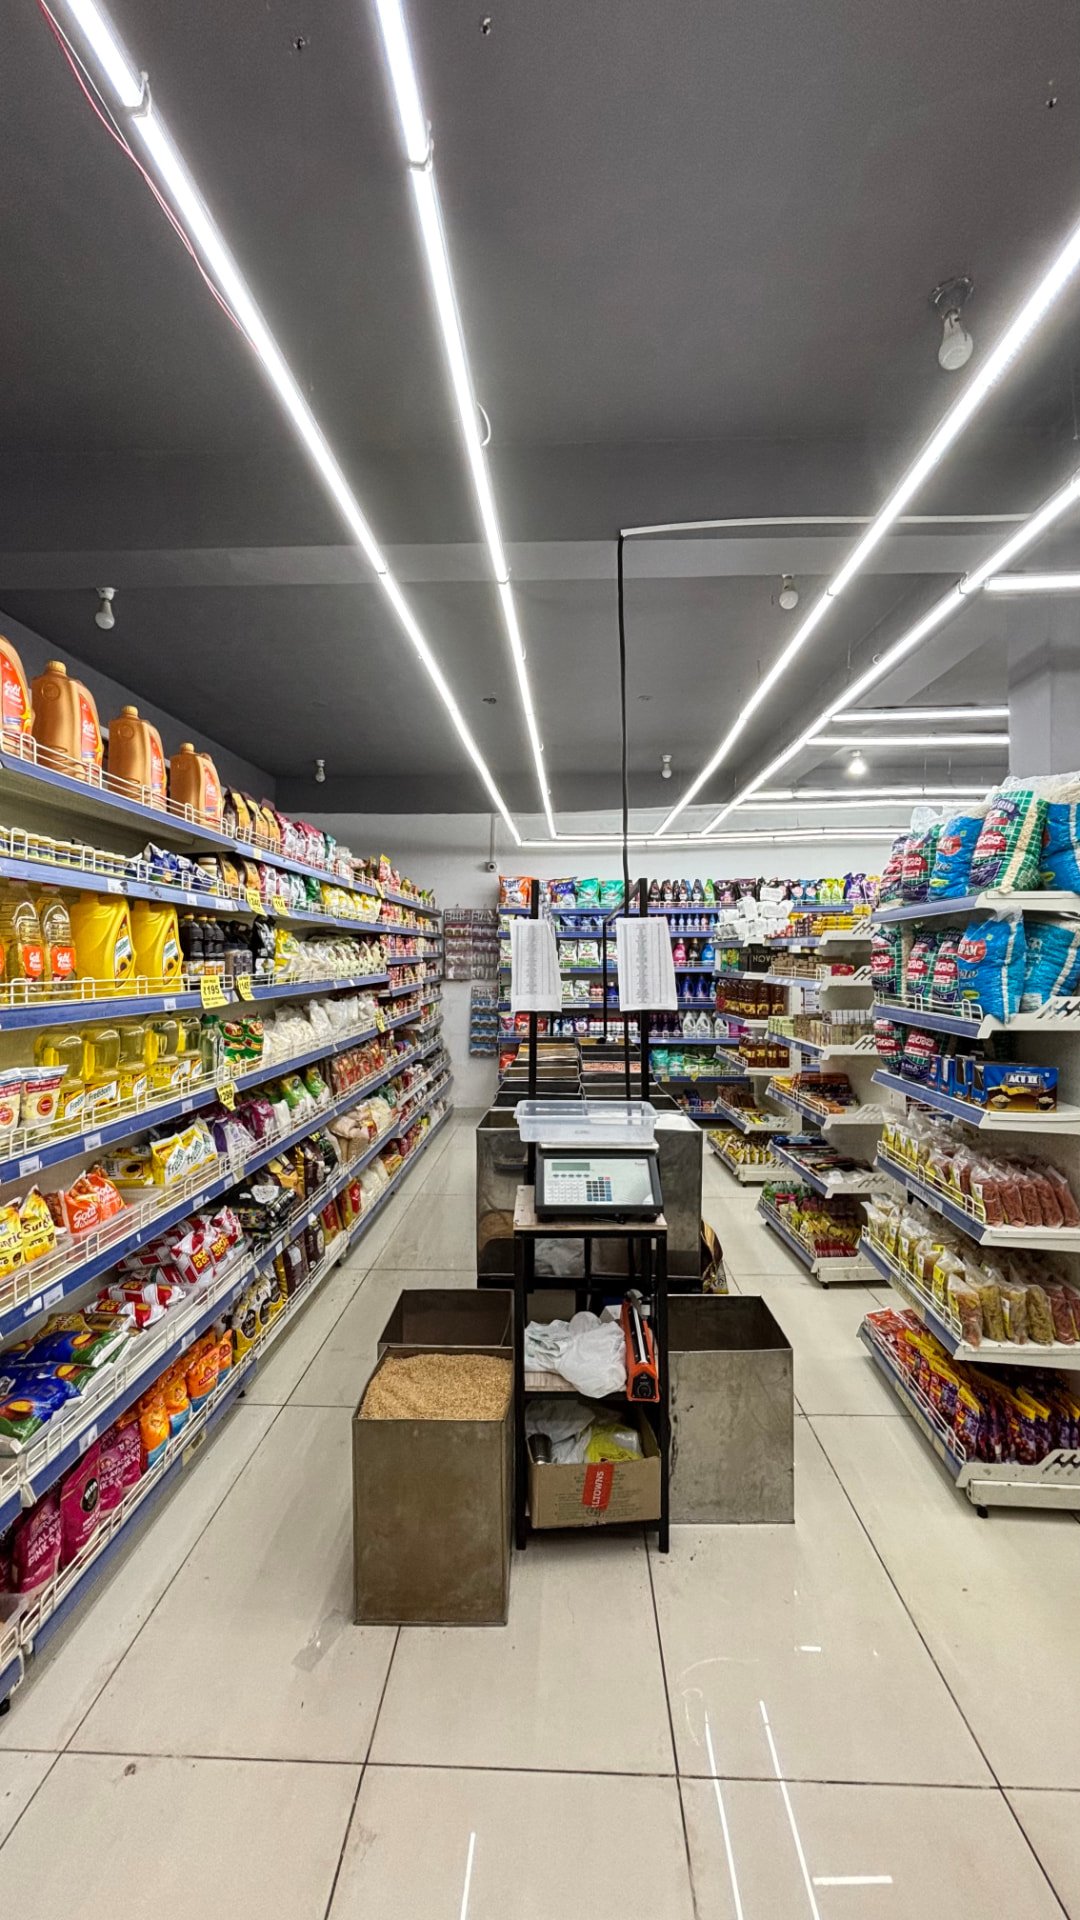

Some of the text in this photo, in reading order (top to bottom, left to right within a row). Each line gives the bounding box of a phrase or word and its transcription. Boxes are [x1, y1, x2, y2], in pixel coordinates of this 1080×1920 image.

[1009, 1075, 1026, 1083] ACT
[72, 1202, 97, 1222] Gold
[28, 1541, 50, 1567] PINK
